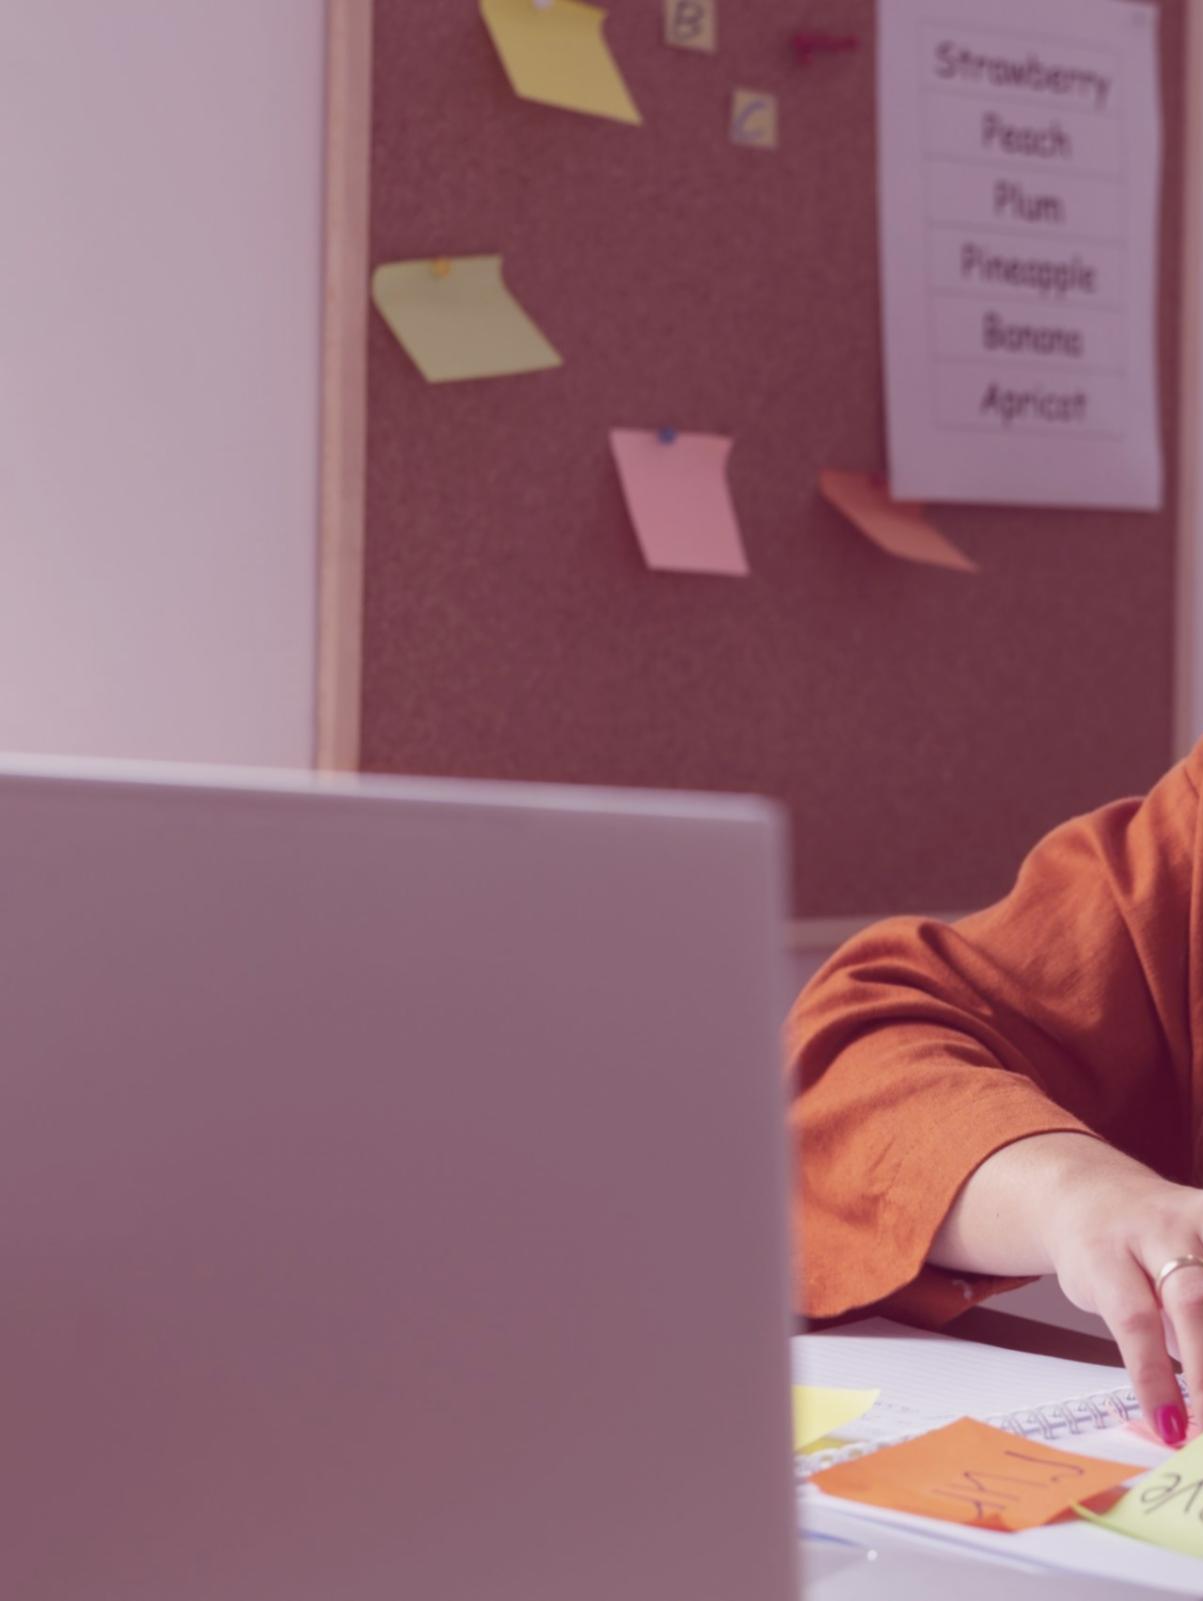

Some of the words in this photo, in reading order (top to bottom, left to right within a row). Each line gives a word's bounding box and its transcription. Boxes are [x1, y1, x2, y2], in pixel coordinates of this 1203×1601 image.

[674, 0, 706, 41] B
[934, 39, 1111, 110] Strawberry
[733, 99, 766, 140] C
[981, 110, 1072, 159] Peach
[993, 179, 1065, 224] Plum
[961, 242, 1096, 299] Pineapple
[982, 311, 1084, 357] Banana
[978, 381, 1089, 427] Apricot
